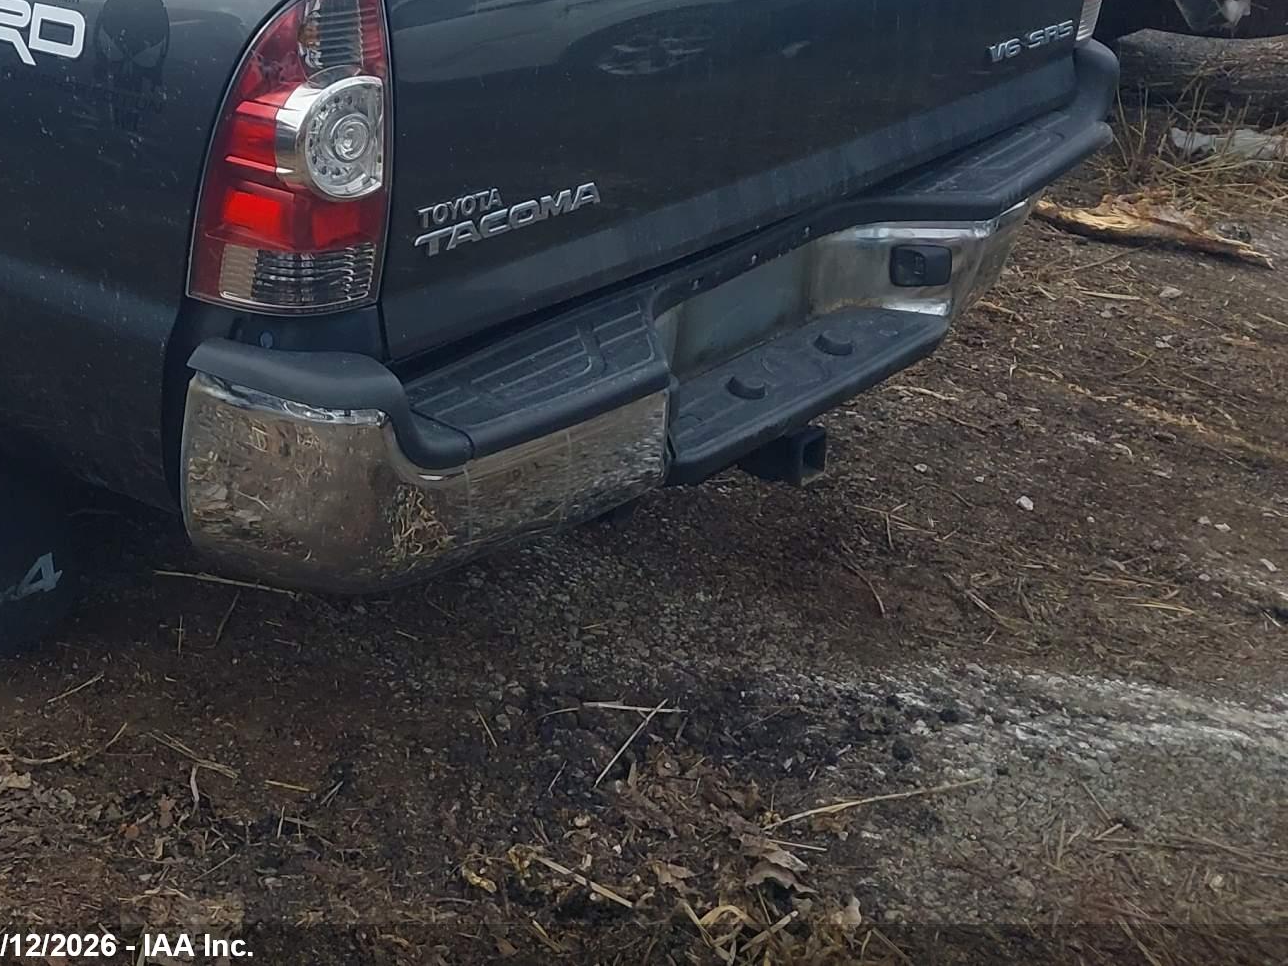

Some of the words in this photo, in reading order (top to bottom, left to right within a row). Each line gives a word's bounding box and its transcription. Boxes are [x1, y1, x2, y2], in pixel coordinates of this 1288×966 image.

[988, 37, 1022, 63] V6
[414, 181, 601, 257] TACOMA
[418, 187, 503, 229] TOYOTA
